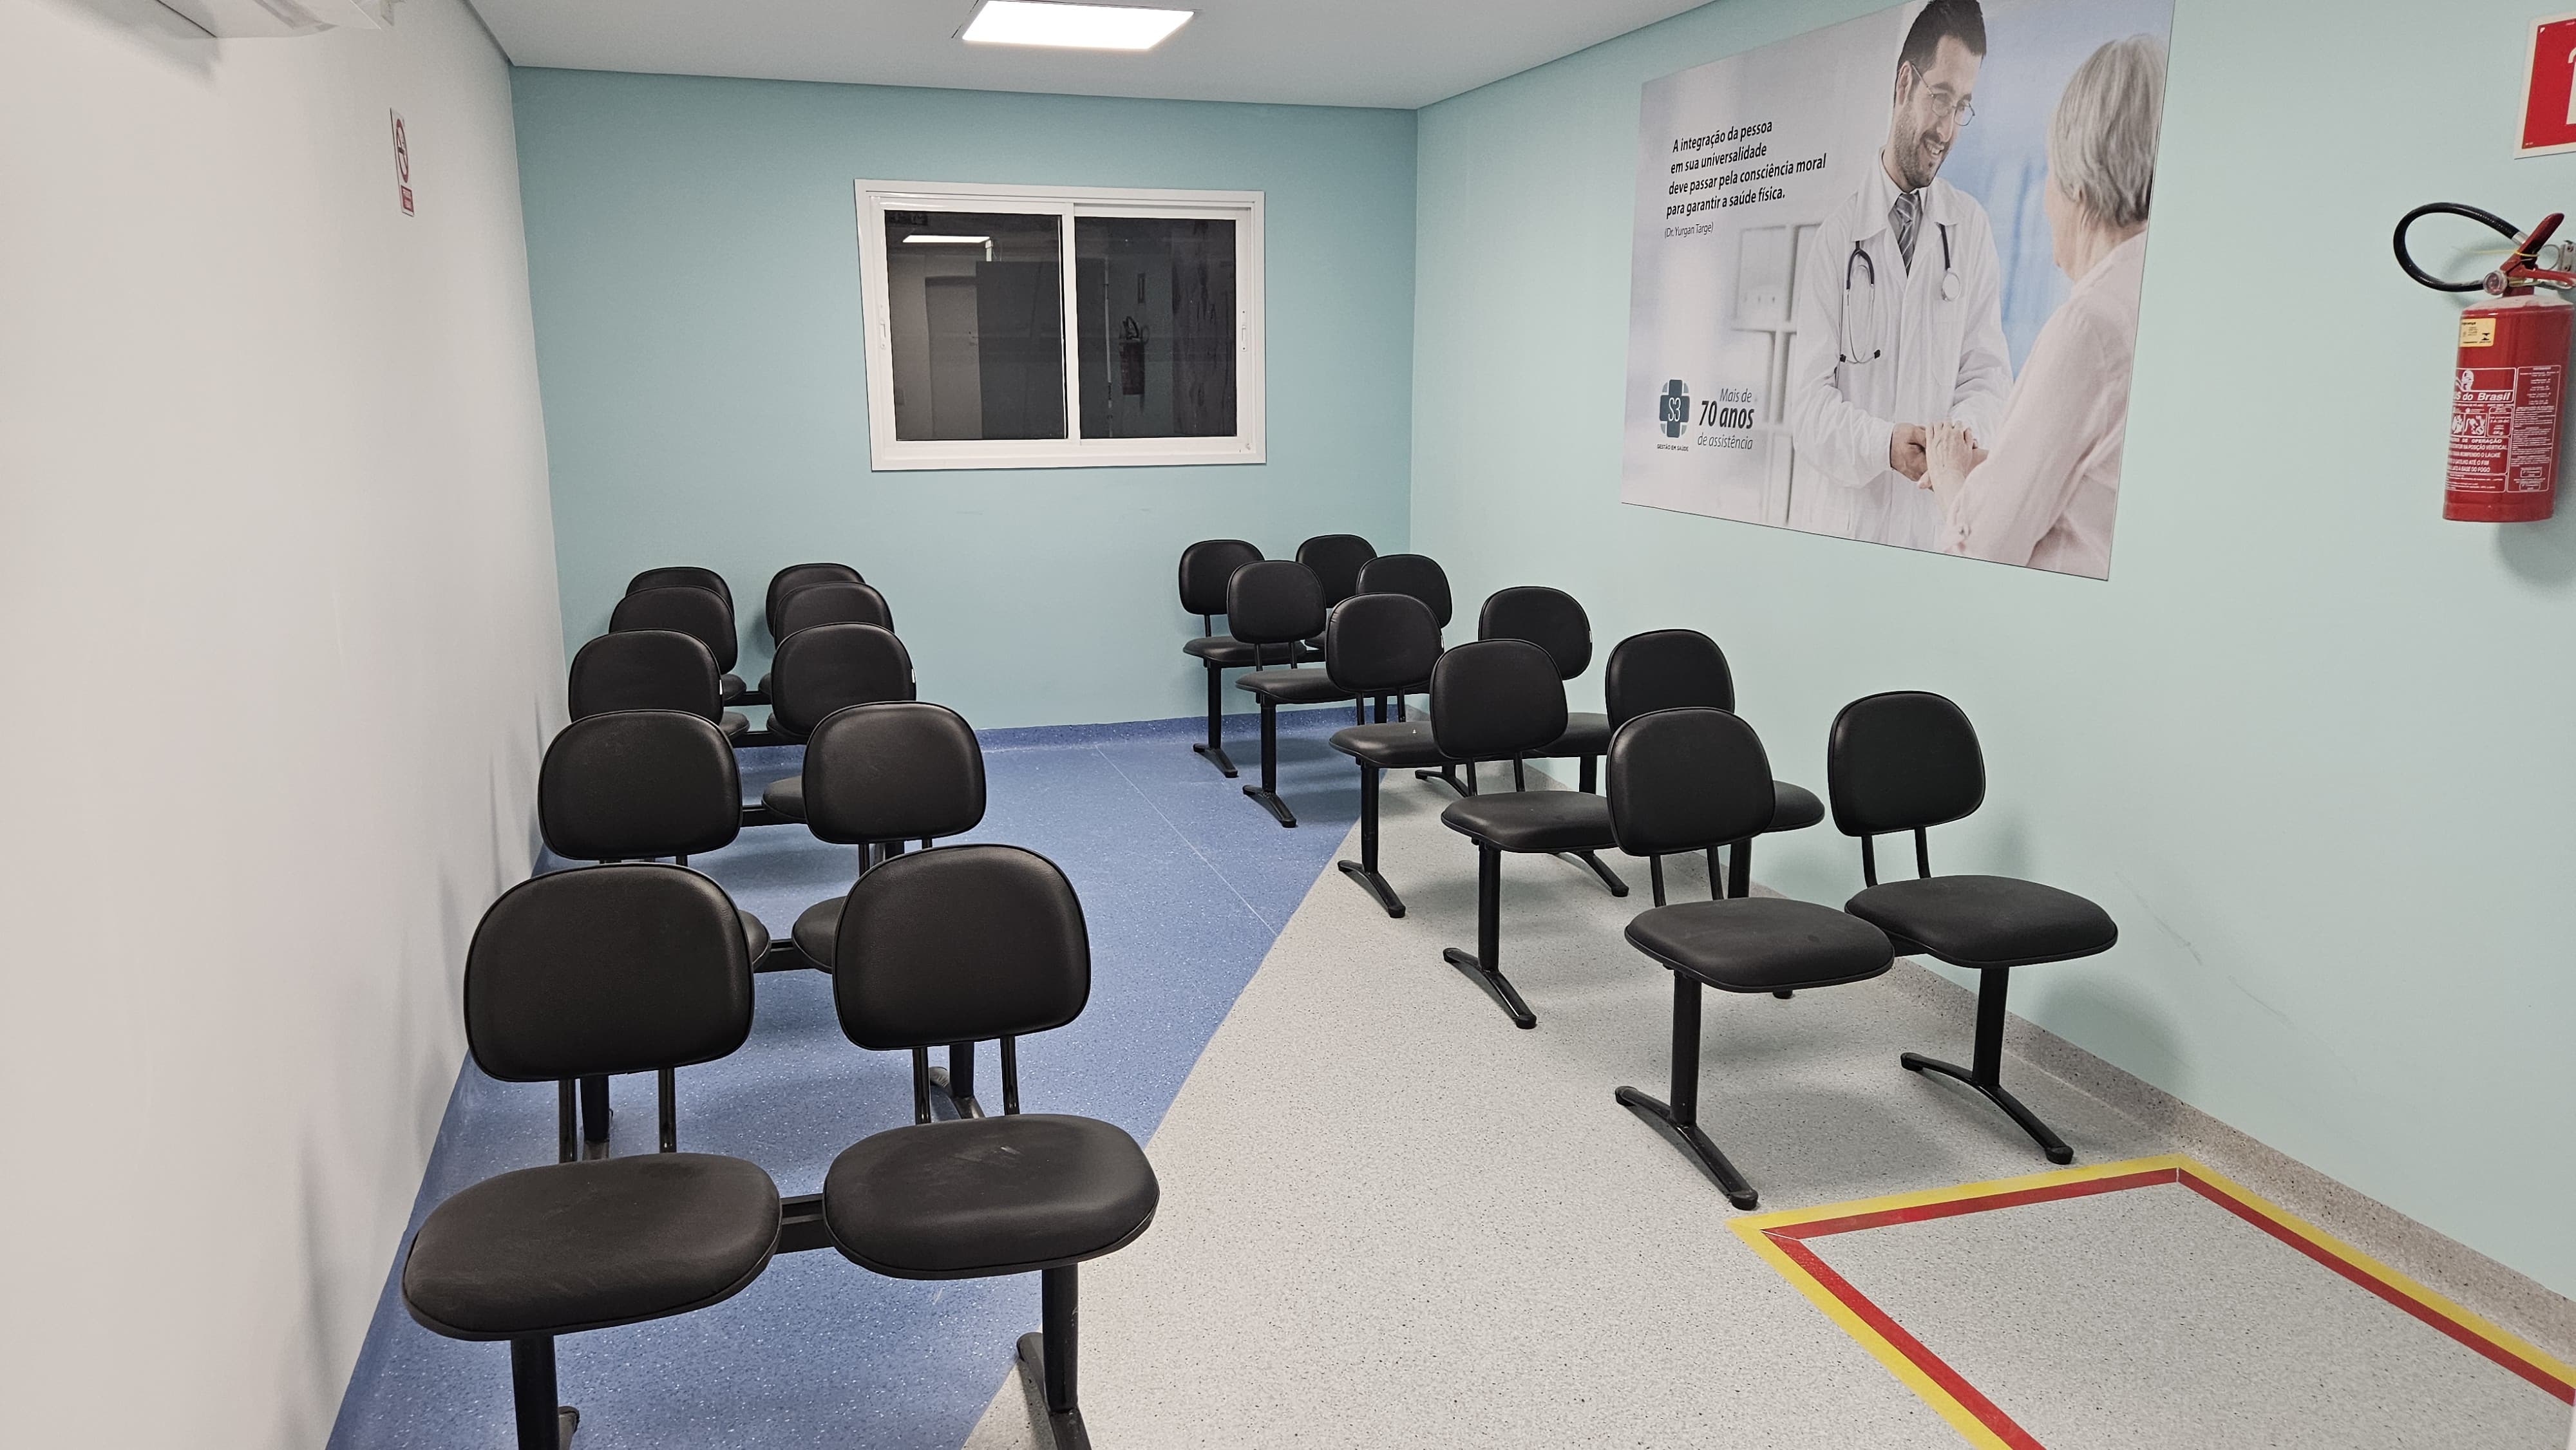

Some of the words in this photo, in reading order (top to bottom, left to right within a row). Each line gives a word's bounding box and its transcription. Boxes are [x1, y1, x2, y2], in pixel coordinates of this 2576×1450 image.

[1672, 139, 1678, 153] A
[1680, 130, 1725, 150] integração
[1727, 126, 1738, 141] da
[1740, 120, 1772, 142] pessoa
[1671, 162, 1683, 174] em
[1685, 159, 1699, 171] sua
[1701, 142, 1767, 168] universalidade
[1669, 181, 1688, 195] deve
[1689, 176, 1718, 195] passar
[1718, 170, 1738, 190] pela
[1739, 160, 1794, 183] consciência
[1795, 153, 1827, 173] moral
[1666, 204, 1685, 220] para
[1686, 195, 1721, 216] garantir
[1722, 197, 1727, 207] a
[1729, 189, 1756, 207] saúde
[1758, 186, 1785, 202] física.
[1664, 227, 1674, 239] (Dr.
[1674, 225, 1695, 238] Yurgan
[1696, 221, 1714, 235] Targe)
[1719, 388, 1739, 402] Mais
[1741, 388, 1752, 402] de
[2463, 392, 2474, 400] do
[2477, 392, 2511, 401] Brasil
[1668, 397, 1681, 422] S3
[1699, 400, 1718, 427] 70
[1719, 407, 1755, 429] anos
[1698, 433, 1707, 446] de
[1709, 434, 1753, 450] assistência
